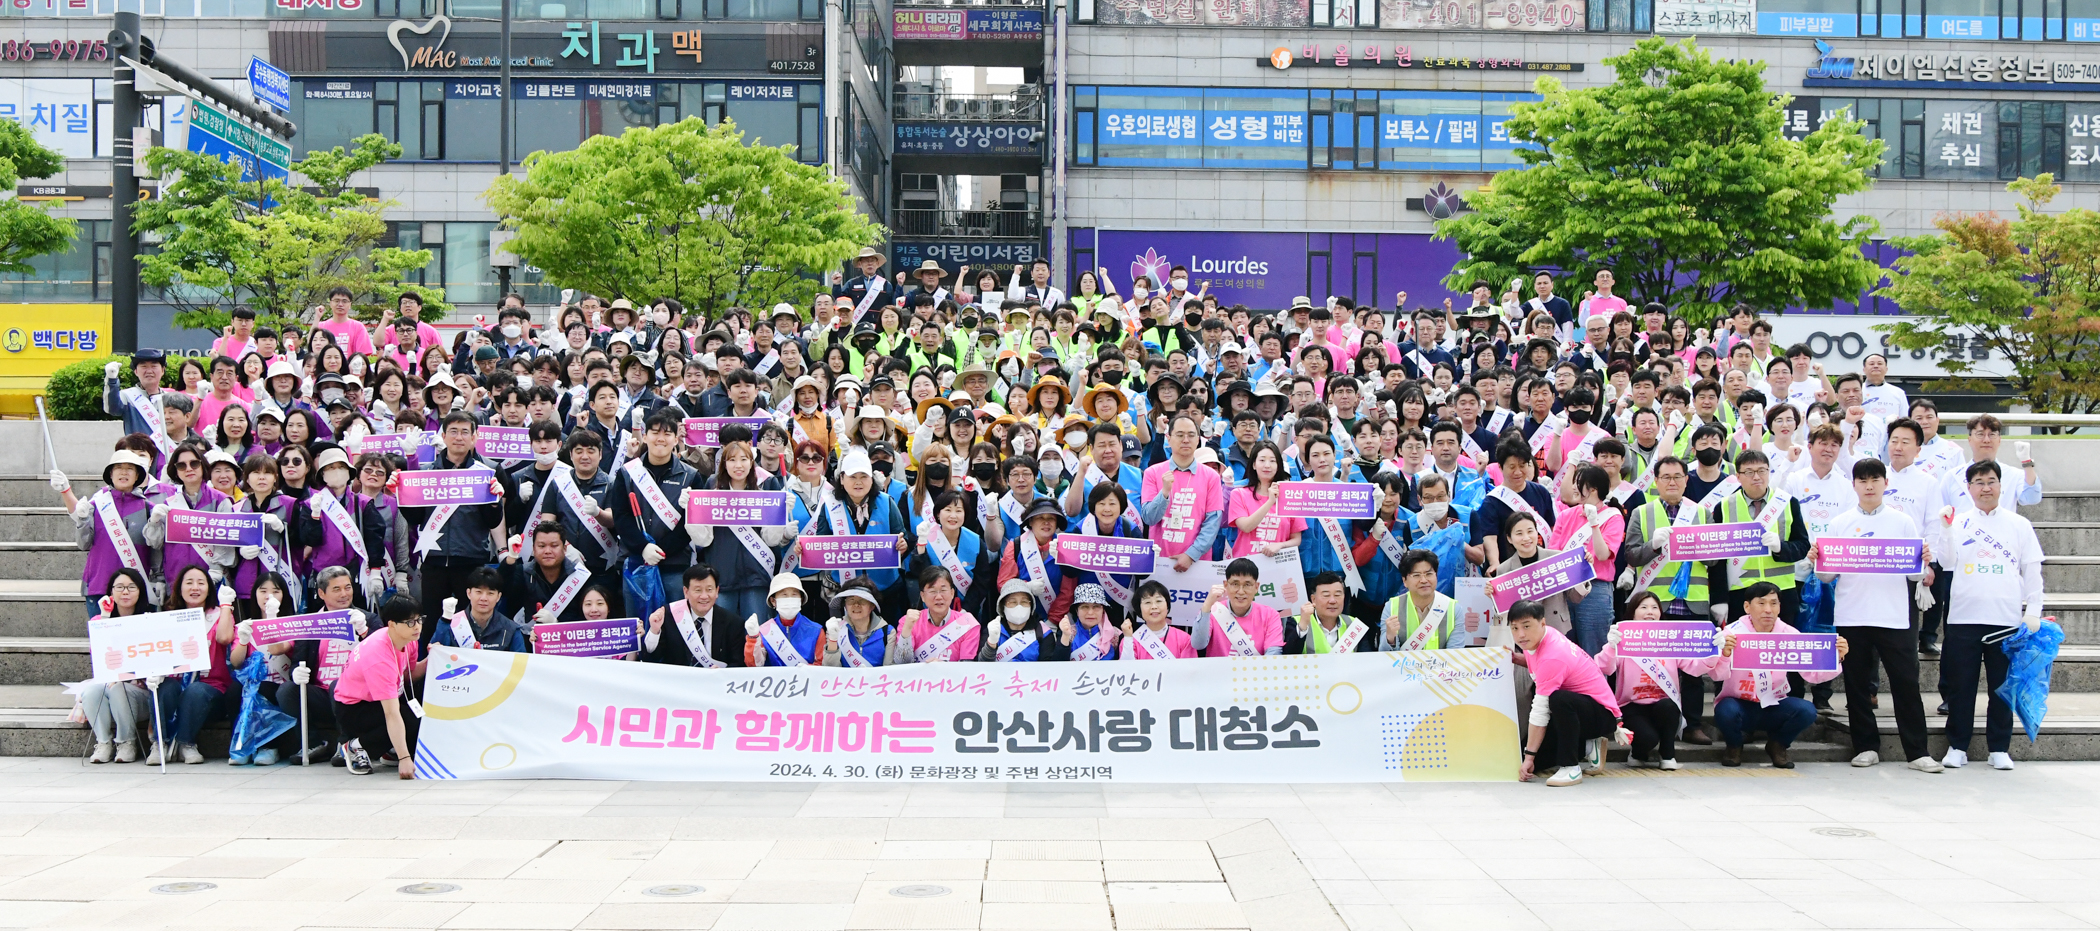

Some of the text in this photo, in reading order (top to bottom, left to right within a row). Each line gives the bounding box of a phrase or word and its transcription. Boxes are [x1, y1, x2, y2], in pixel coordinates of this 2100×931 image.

[895, 12, 923, 24] 허니
[1658, 11, 1751, 29] 스포츠 마사지
[1779, 16, 1834, 33] 피부질환
[968, 20, 1042, 32] 세무회계사무소
[1941, 20, 1983, 36] 여드름
[0, 39, 107, 61] 86-9975
[411, 46, 456, 68] MAC
[806, 47, 816, 56] 3F
[1302, 44, 1412, 67] 비올의원
[460, 56, 483, 66] Most
[770, 61, 816, 71] 401.7528
[1423, 56, 1471, 68] 진료과목
[1476, 57, 1523, 69] 성형외과
[1859, 54, 2050, 82] 제이엠신용정보
[525, 84, 576, 97] 임플란트
[589, 84, 652, 98] 미세현미경치료
[731, 85, 793, 98] 레이저치료
[30, 103, 88, 133] 치질
[1272, 115, 1303, 127] 피부
[1942, 112, 1982, 135] 채권
[897, 126, 947, 138] 통합독서논술
[1105, 114, 1267, 141] 우호의료생협 성형
[1384, 120, 1430, 143] 보톡스
[1448, 120, 1477, 143] 필러
[1272, 129, 1303, 143] 비만
[1940, 143, 1982, 166] 추심
[897, 246, 919, 254] 키즈
[927, 244, 1033, 263] 어린이서점
[900, 256, 922, 267] 킹콩
[1191, 255, 1269, 275] Lourdes
[33, 330, 98, 350] 빽다방
[690, 422, 720, 431] 이민청은
[404, 475, 490, 487] 이민청은 상호문화도시
[422, 487, 474, 500] 안산으로
[1284, 490, 1303, 499] 안산
[1341, 491, 1368, 500] 최적지
[694, 497, 780, 507] 이민청은 상호문화도시
[712, 508, 762, 520] 안산으로
[173, 514, 258, 529] 이민청은 상호문화도시
[190, 527, 240, 541] 안산으로
[1676, 533, 1694, 543] 안산
[1733, 529, 1761, 539] 최적지
[806, 542, 892, 550] 이민청은 상호문화도시
[1062, 541, 1150, 554] 이민청은 상호문화도시
[1824, 545, 1843, 555] 안산
[1885, 546, 1915, 556] 최적지
[824, 551, 874, 564] 안산으로
[1080, 553, 1130, 568] 안산으로
[1496, 574, 1530, 592] 이민청은
[1532, 554, 1582, 579] 상호문화도시
[1978, 564, 2003, 574] 농협
[1518, 572, 1570, 600] 안산으로
[257, 624, 277, 632] 안산
[317, 617, 348, 625] 최적지
[541, 632, 561, 642] 안산
[601, 627, 630, 638] 최적지
[1623, 629, 1712, 639] 안산 최적지
[127, 640, 174, 658] 5구역
[1740, 640, 1831, 650] 이민청은 상호문화도시
[1759, 652, 1812, 666] 안산으로
[440, 684, 471, 694] 안산시
[726, 669, 1162, 698] 제20회 안산국제거리극 축제 손님맞이
[561, 705, 1321, 755] 시민과 함께하는 안산사랑 대청소
[770, 763, 1113, 780] 2024. 4. 30. (화) 문화광장 및 주변 상업지역
